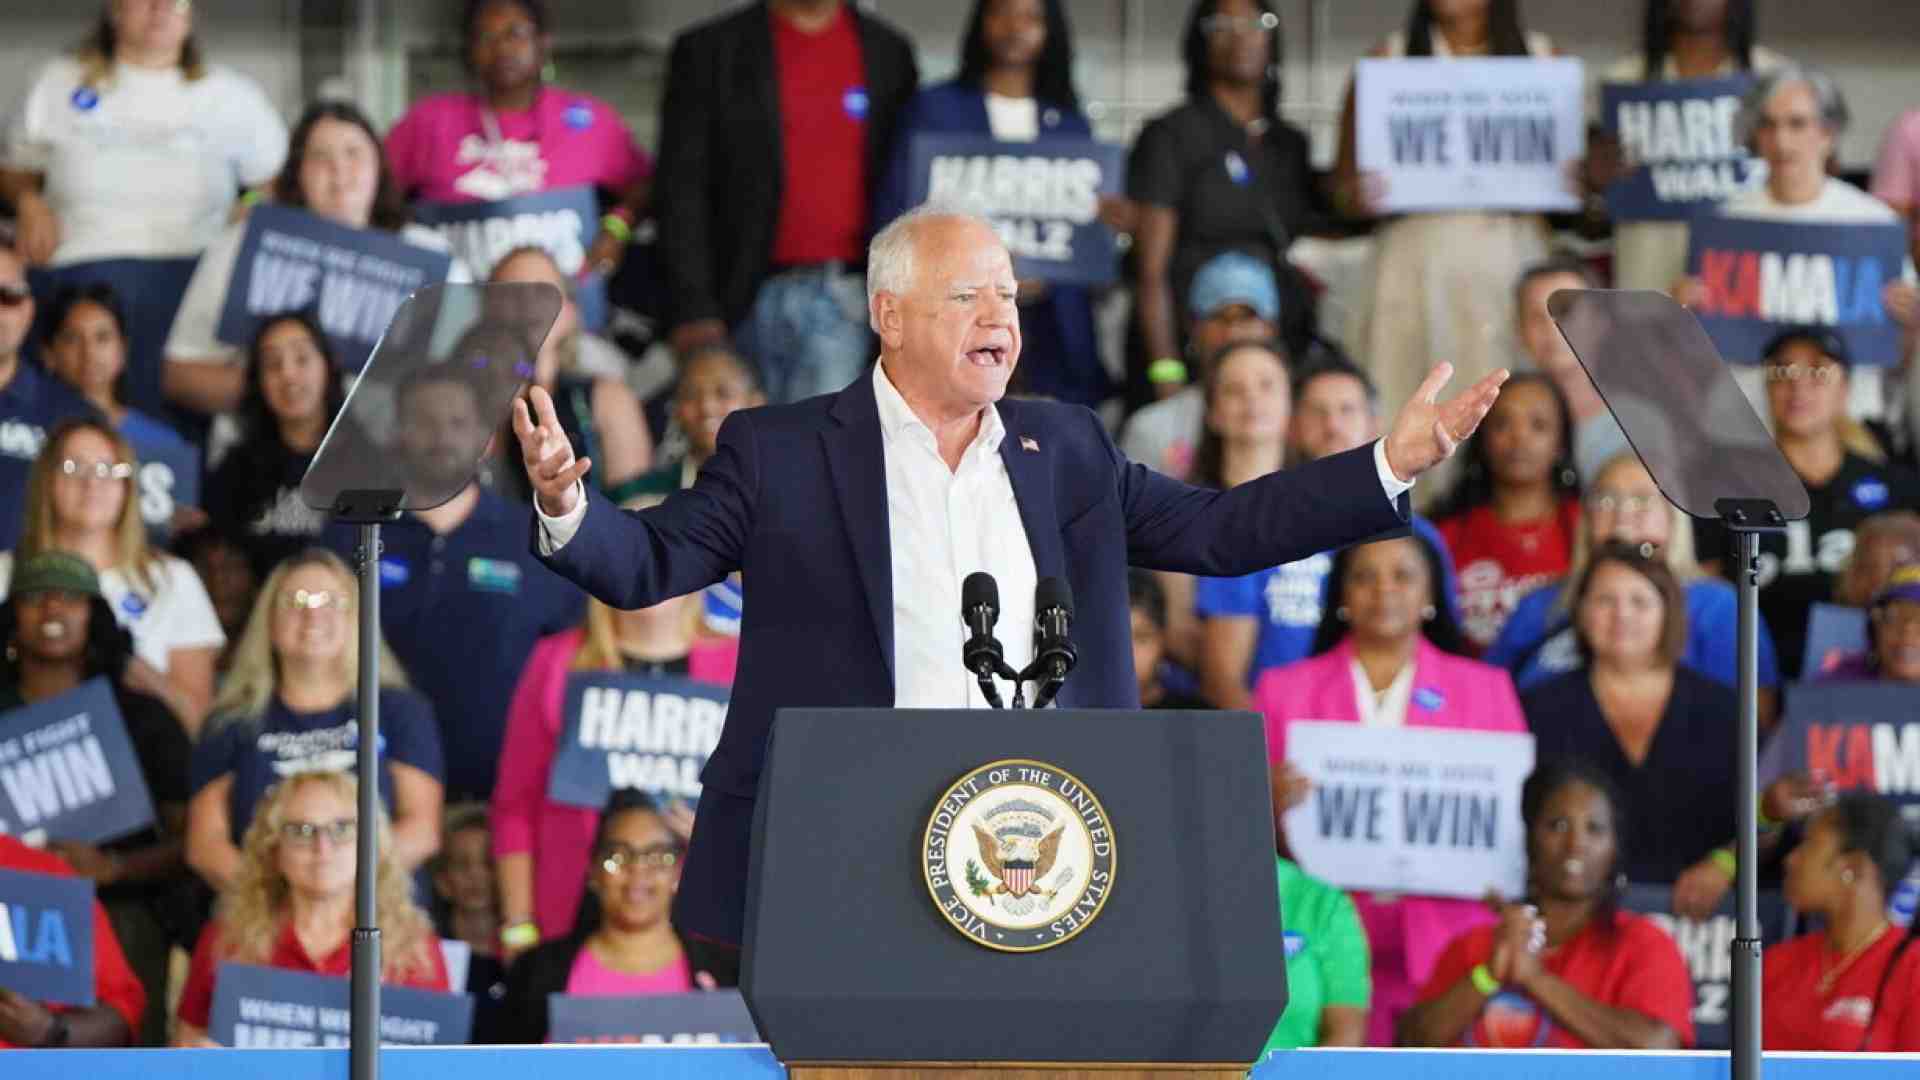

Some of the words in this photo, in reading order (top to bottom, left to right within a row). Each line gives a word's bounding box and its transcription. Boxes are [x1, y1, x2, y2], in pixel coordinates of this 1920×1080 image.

[1389, 114, 1448, 165] WE
[1467, 114, 1556, 165] WIN
[928, 155, 1103, 225] HARRIS
[248, 250, 321, 315] WE
[1702, 247, 1887, 327] KAMALA
[22, 711, 91, 756] FIGHT
[0, 732, 116, 828] WIN
[988, 768, 1011, 785] OF
[1018, 767, 1051, 785] THE
[928, 777, 979, 888] PRESIDENT
[1058, 779, 1110, 857] UNITED
[1317, 783, 1383, 842] WE
[1402, 790, 1497, 848] WIN
[944, 894, 987, 939] VICE
[1051, 869, 1109, 938] STATES
[239, 997, 316, 1030] WHEN
